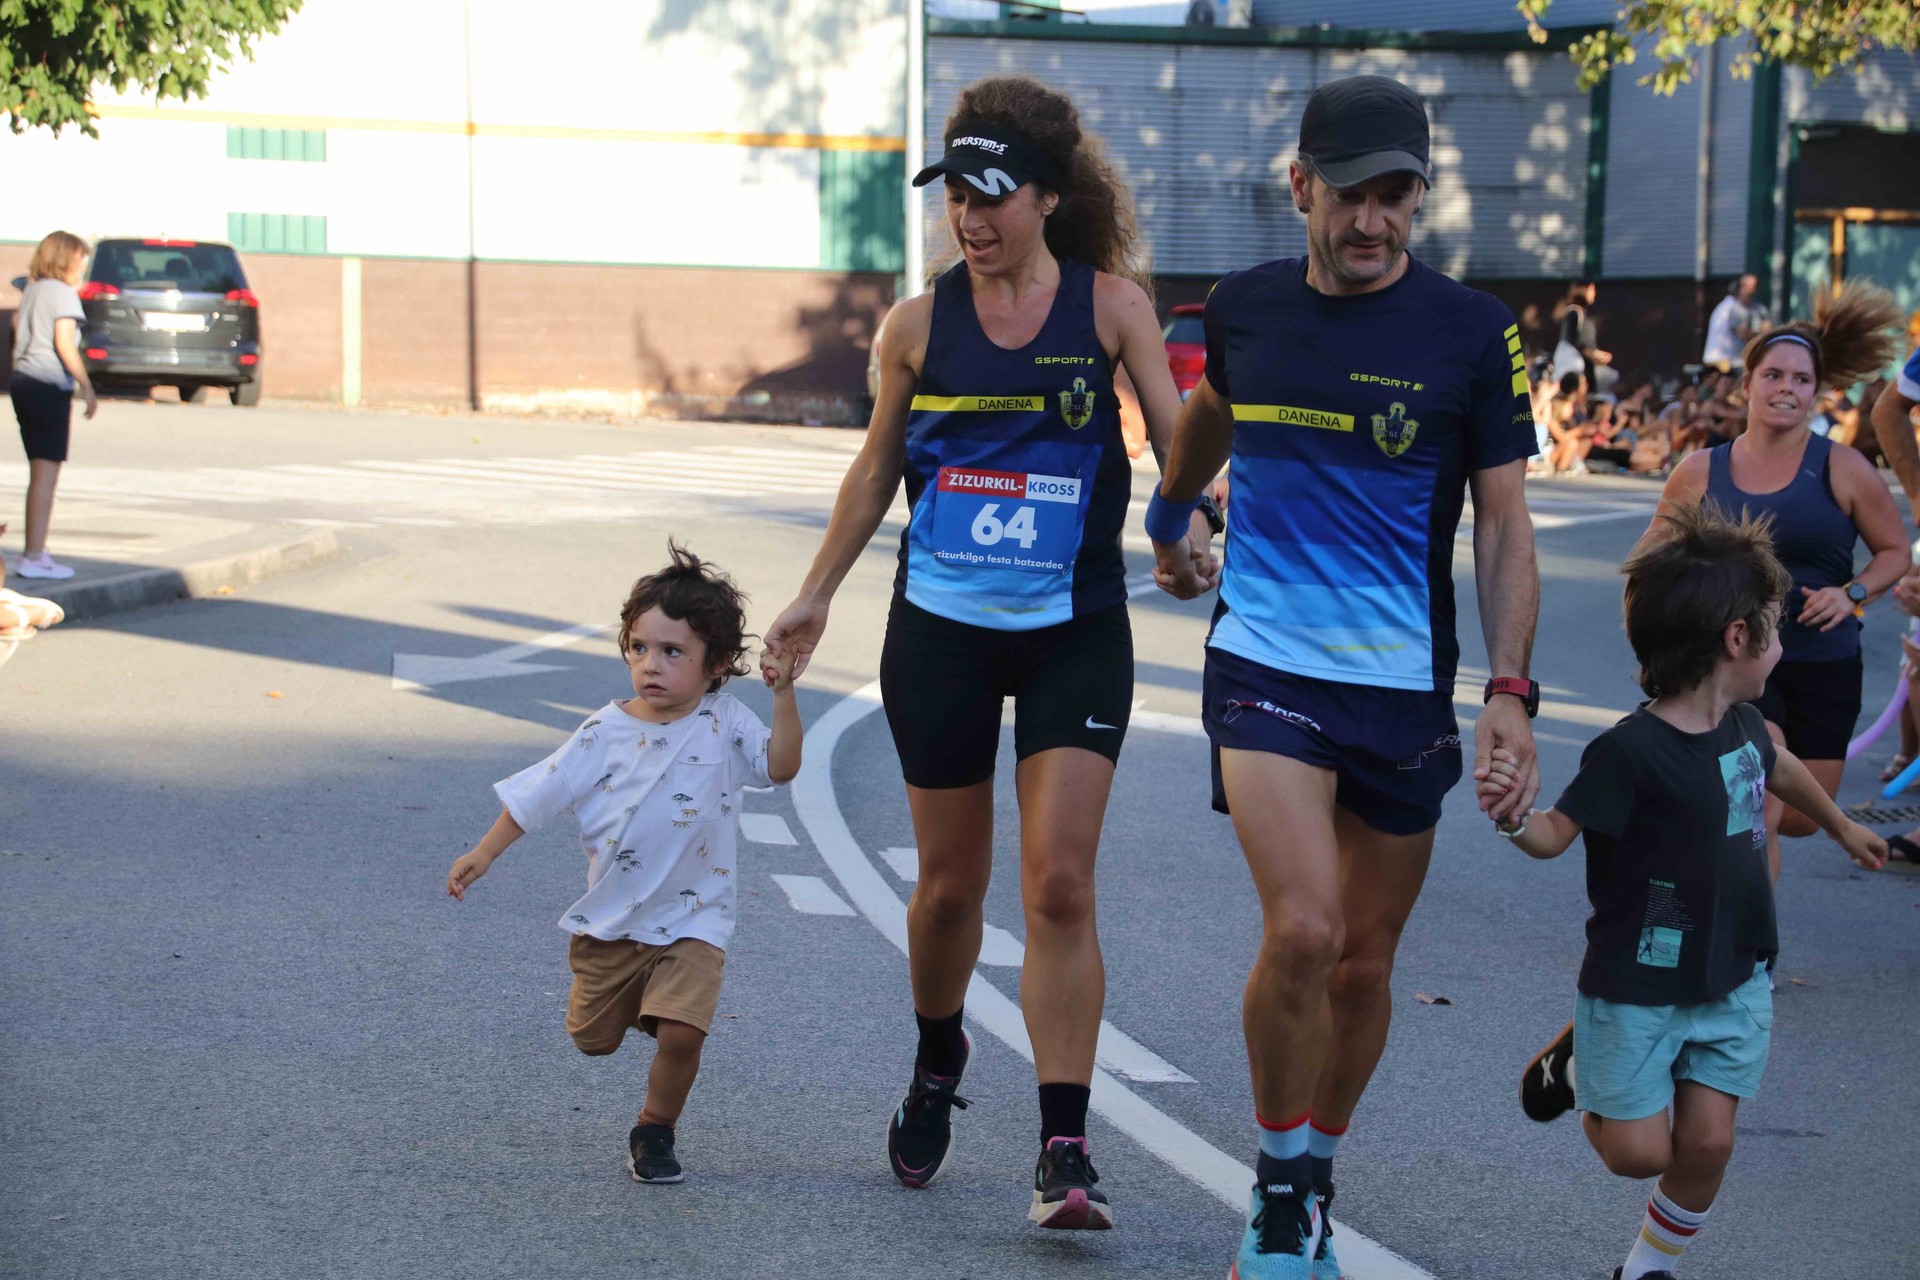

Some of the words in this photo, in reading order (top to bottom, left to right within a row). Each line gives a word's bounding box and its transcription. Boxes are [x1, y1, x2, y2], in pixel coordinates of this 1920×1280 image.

[1035, 356, 1086, 365] GSPORT
[1350, 373, 1411, 389] GSPORT
[978, 398, 1034, 410] DANENA
[1278, 408, 1342, 429] DANENA
[948, 473, 1024, 491] ZIZURKIL-
[1028, 481, 1076, 497] KROSS
[971, 503, 1038, 549] 64
[987, 554, 1012, 566] festa
[1014, 557, 1064, 570] batzordea
[1267, 1184, 1294, 1193] HOKA
